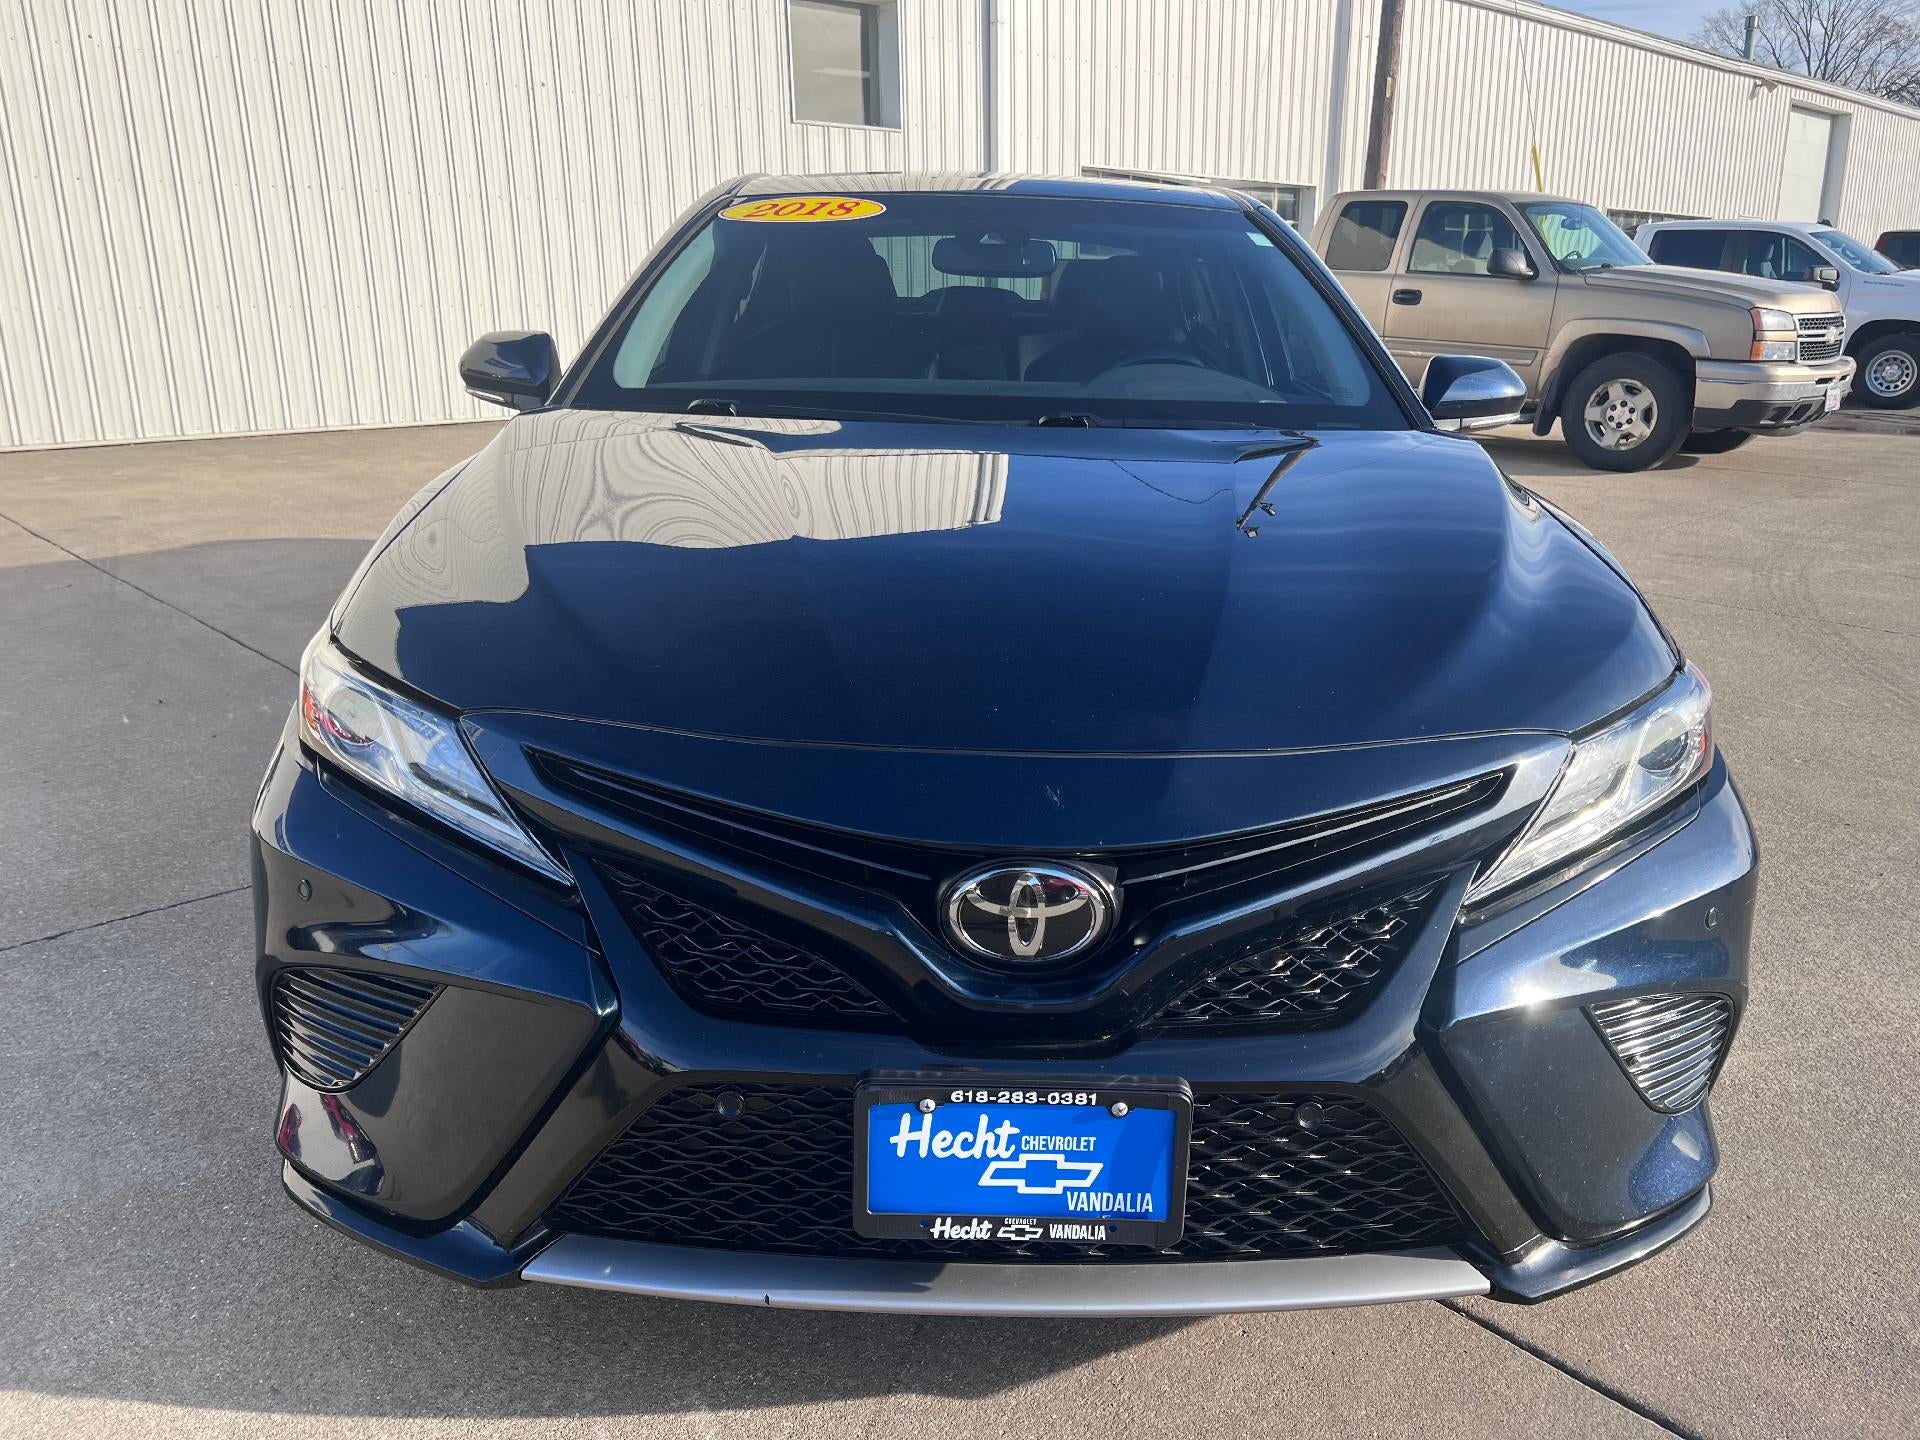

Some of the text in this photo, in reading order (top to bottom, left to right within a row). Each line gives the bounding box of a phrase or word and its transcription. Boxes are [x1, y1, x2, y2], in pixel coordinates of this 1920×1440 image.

[743, 201, 861, 218] 2018
[950, 1090, 1097, 1106] 618-283-0381
[889, 1112, 1097, 1159] Hecht CHEVROLET
[1066, 1191, 1153, 1213] VANDALIA
[930, 1216, 993, 1240] Hecht
[1049, 1223, 1106, 1241] VANDALIA
